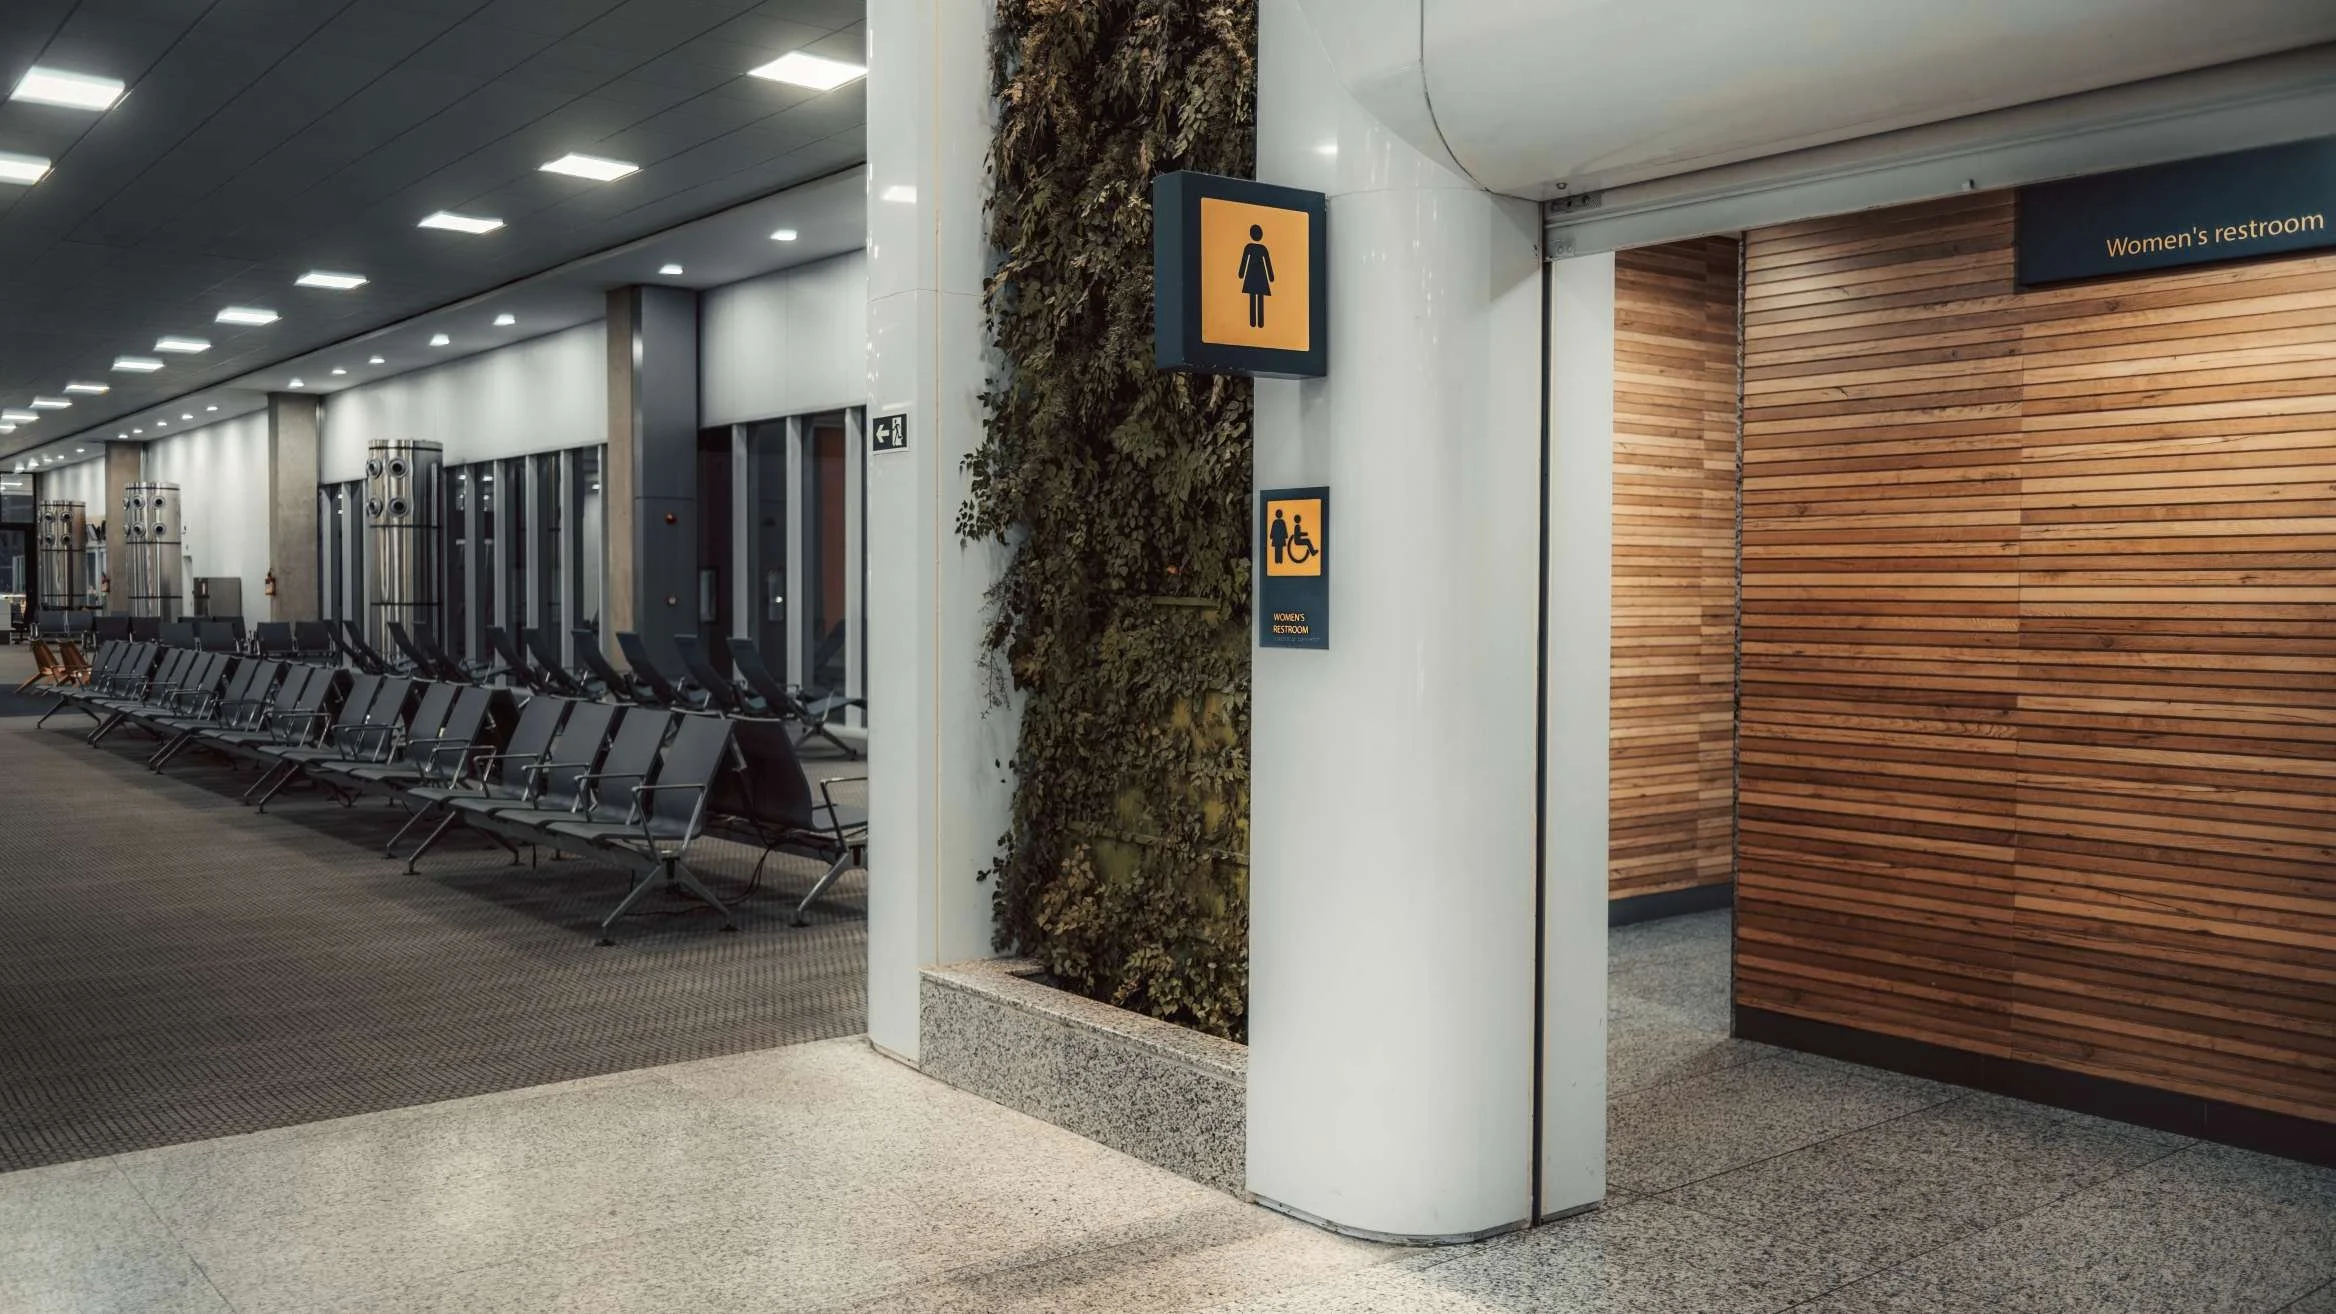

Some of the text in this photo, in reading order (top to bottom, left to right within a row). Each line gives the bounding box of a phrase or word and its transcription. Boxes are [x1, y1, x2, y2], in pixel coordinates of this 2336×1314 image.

[2106, 213, 2324, 257] Women's restroom
[1273, 613, 1305, 622] WOMEN'S
[1273, 625, 1309, 634] RESTROOM
